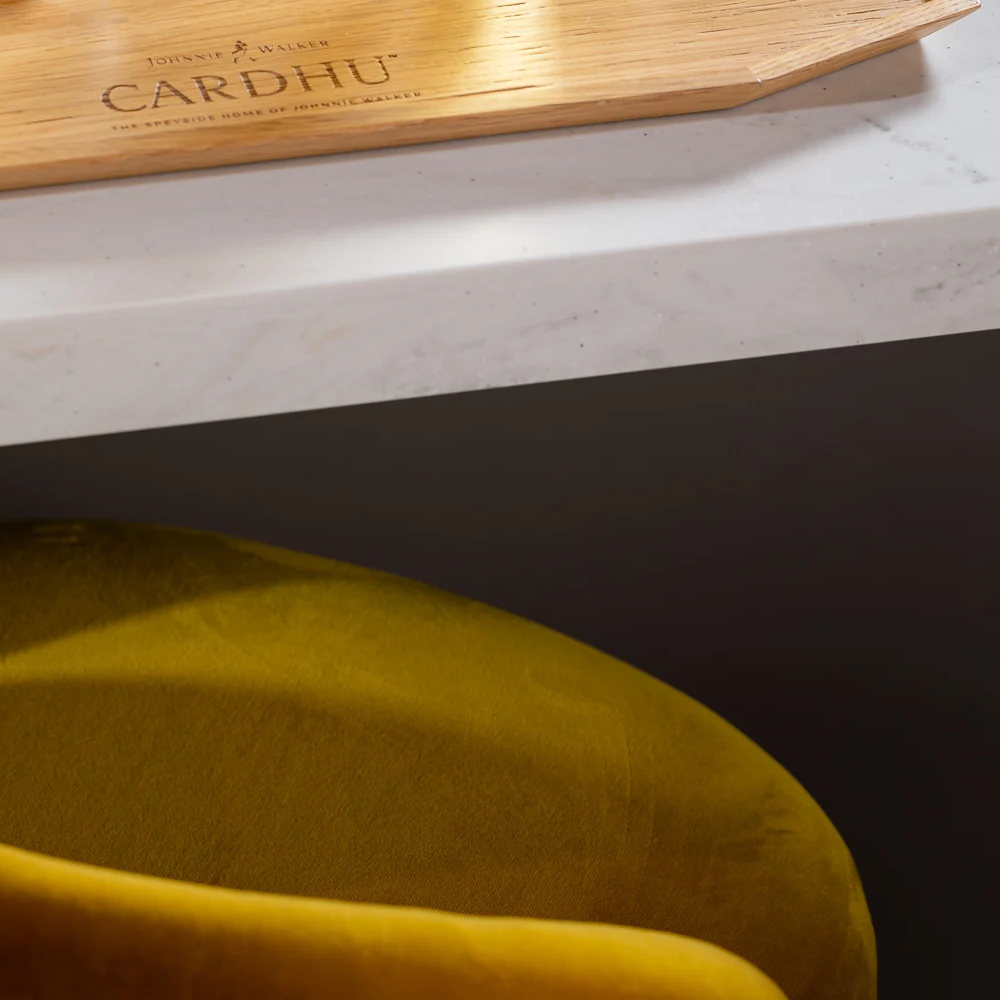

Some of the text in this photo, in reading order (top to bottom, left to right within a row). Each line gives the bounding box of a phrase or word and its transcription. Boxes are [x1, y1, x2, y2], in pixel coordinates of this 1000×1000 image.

[258, 40, 329, 53] WALKER
[112, 91, 421, 131] THE SPEYSIDE HOME OF JOHNNIE WALKER
